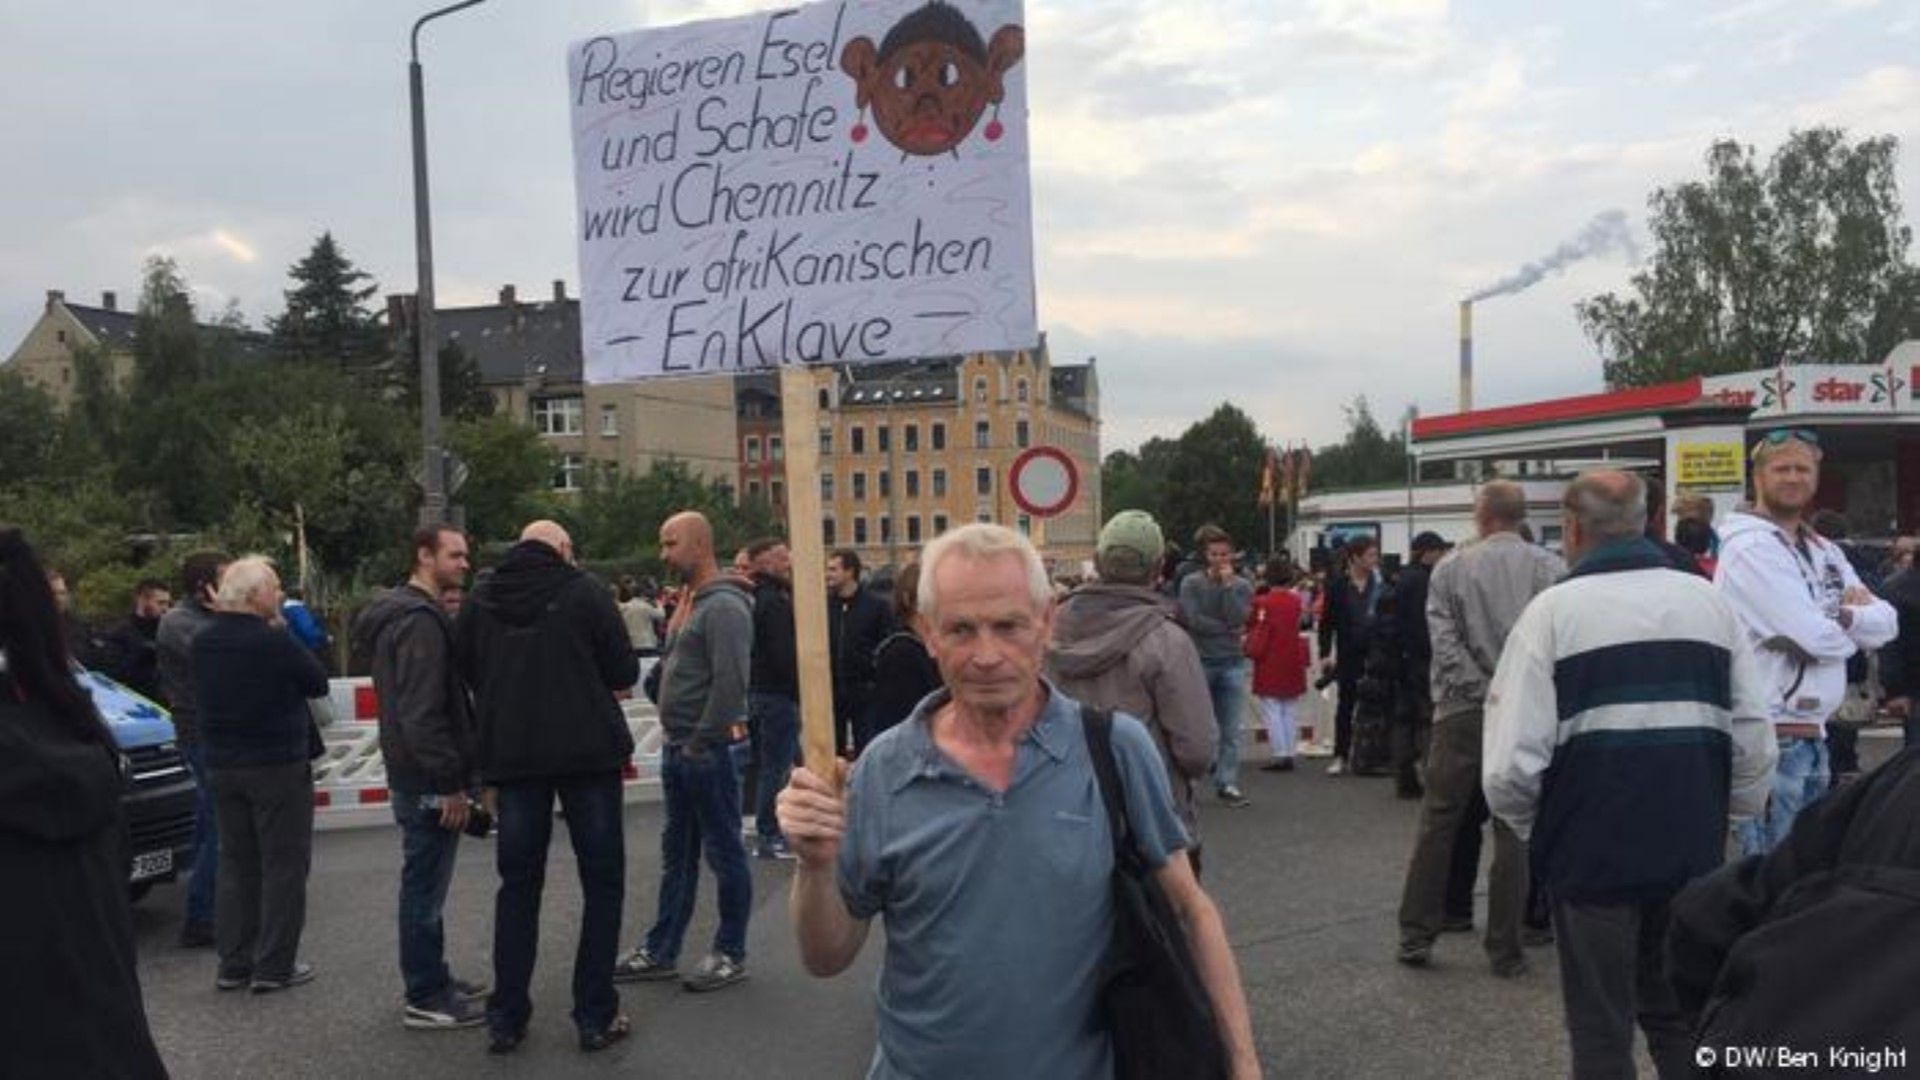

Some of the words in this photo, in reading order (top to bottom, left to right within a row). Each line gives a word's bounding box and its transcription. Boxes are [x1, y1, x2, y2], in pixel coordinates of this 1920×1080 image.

[578, 36, 746, 109] Regieren
[756, 3, 847, 80] Esel
[602, 109, 680, 170] und
[695, 75, 837, 157] Schafe
[584, 183, 664, 241] wird
[671, 151, 880, 229] Chemnitz
[622, 267, 690, 302] zur
[1812, 377, 1866, 402] star
